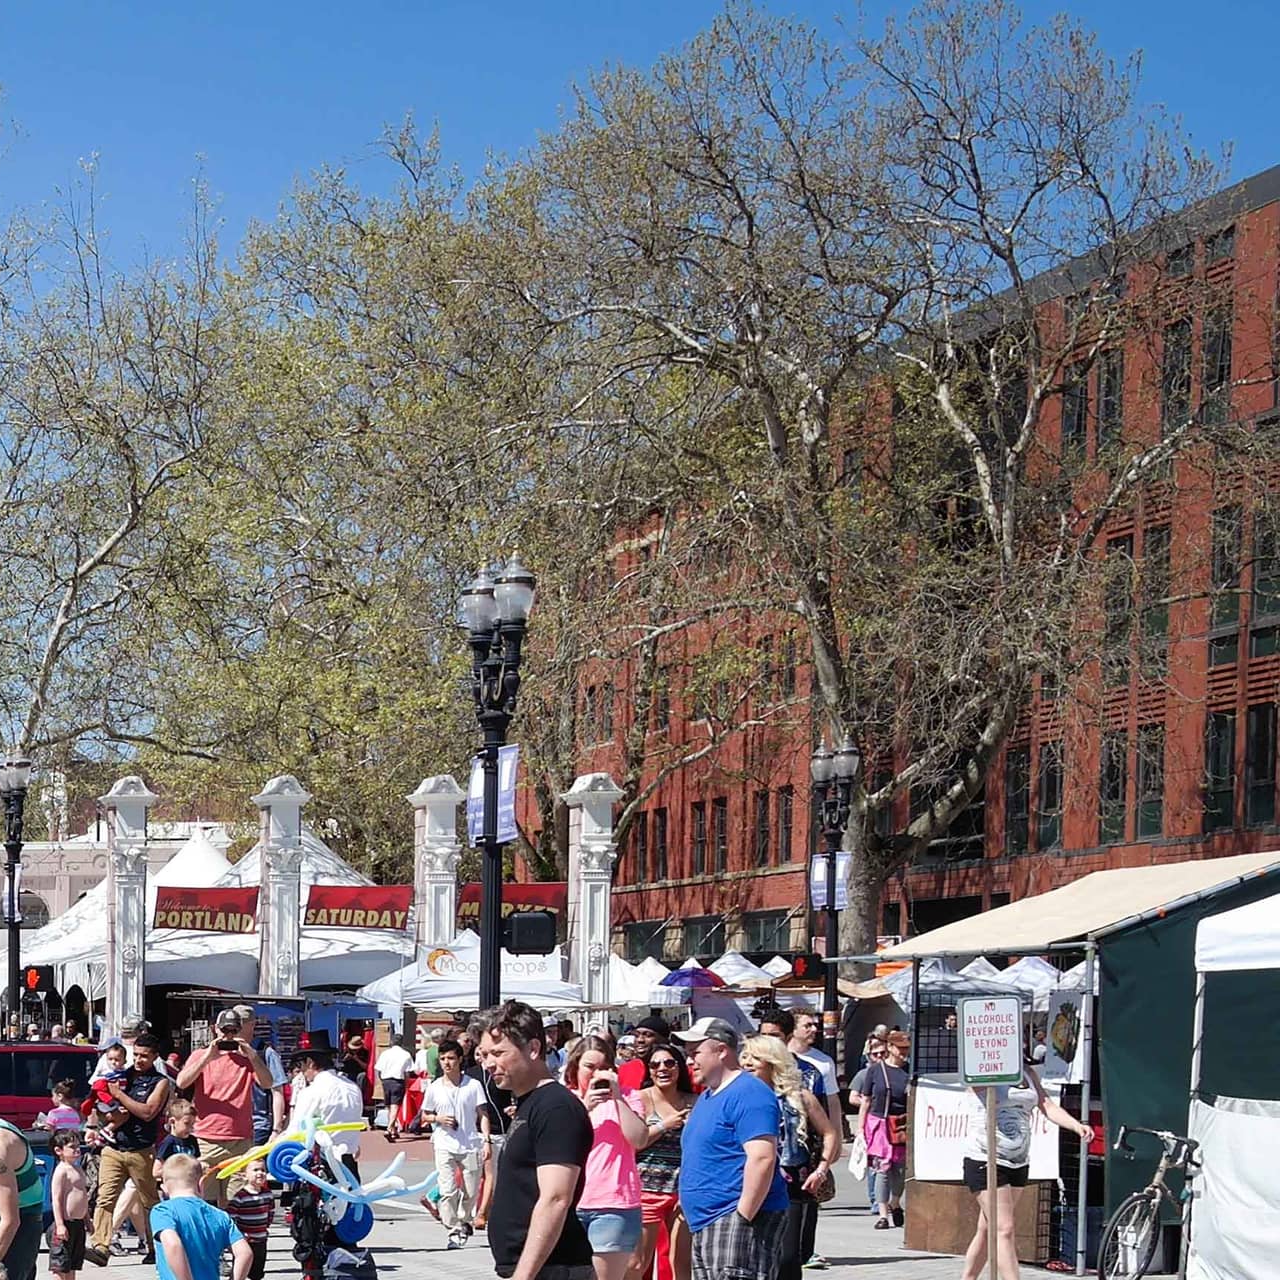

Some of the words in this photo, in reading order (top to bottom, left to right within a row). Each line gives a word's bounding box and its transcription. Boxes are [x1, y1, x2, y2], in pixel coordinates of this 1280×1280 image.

[155, 910, 255, 933] PORTLAND
[305, 908, 408, 929] SATURDAY
[984, 1002, 996, 1012] NO
[968, 1014, 1014, 1025] ALCOHOLIC
[966, 1025, 1016, 1037] BEVERAGES
[974, 1038, 1008, 1049] BEYOND
[981, 1051, 1001, 1060] THIS
[978, 1062, 1005, 1073] POINT
